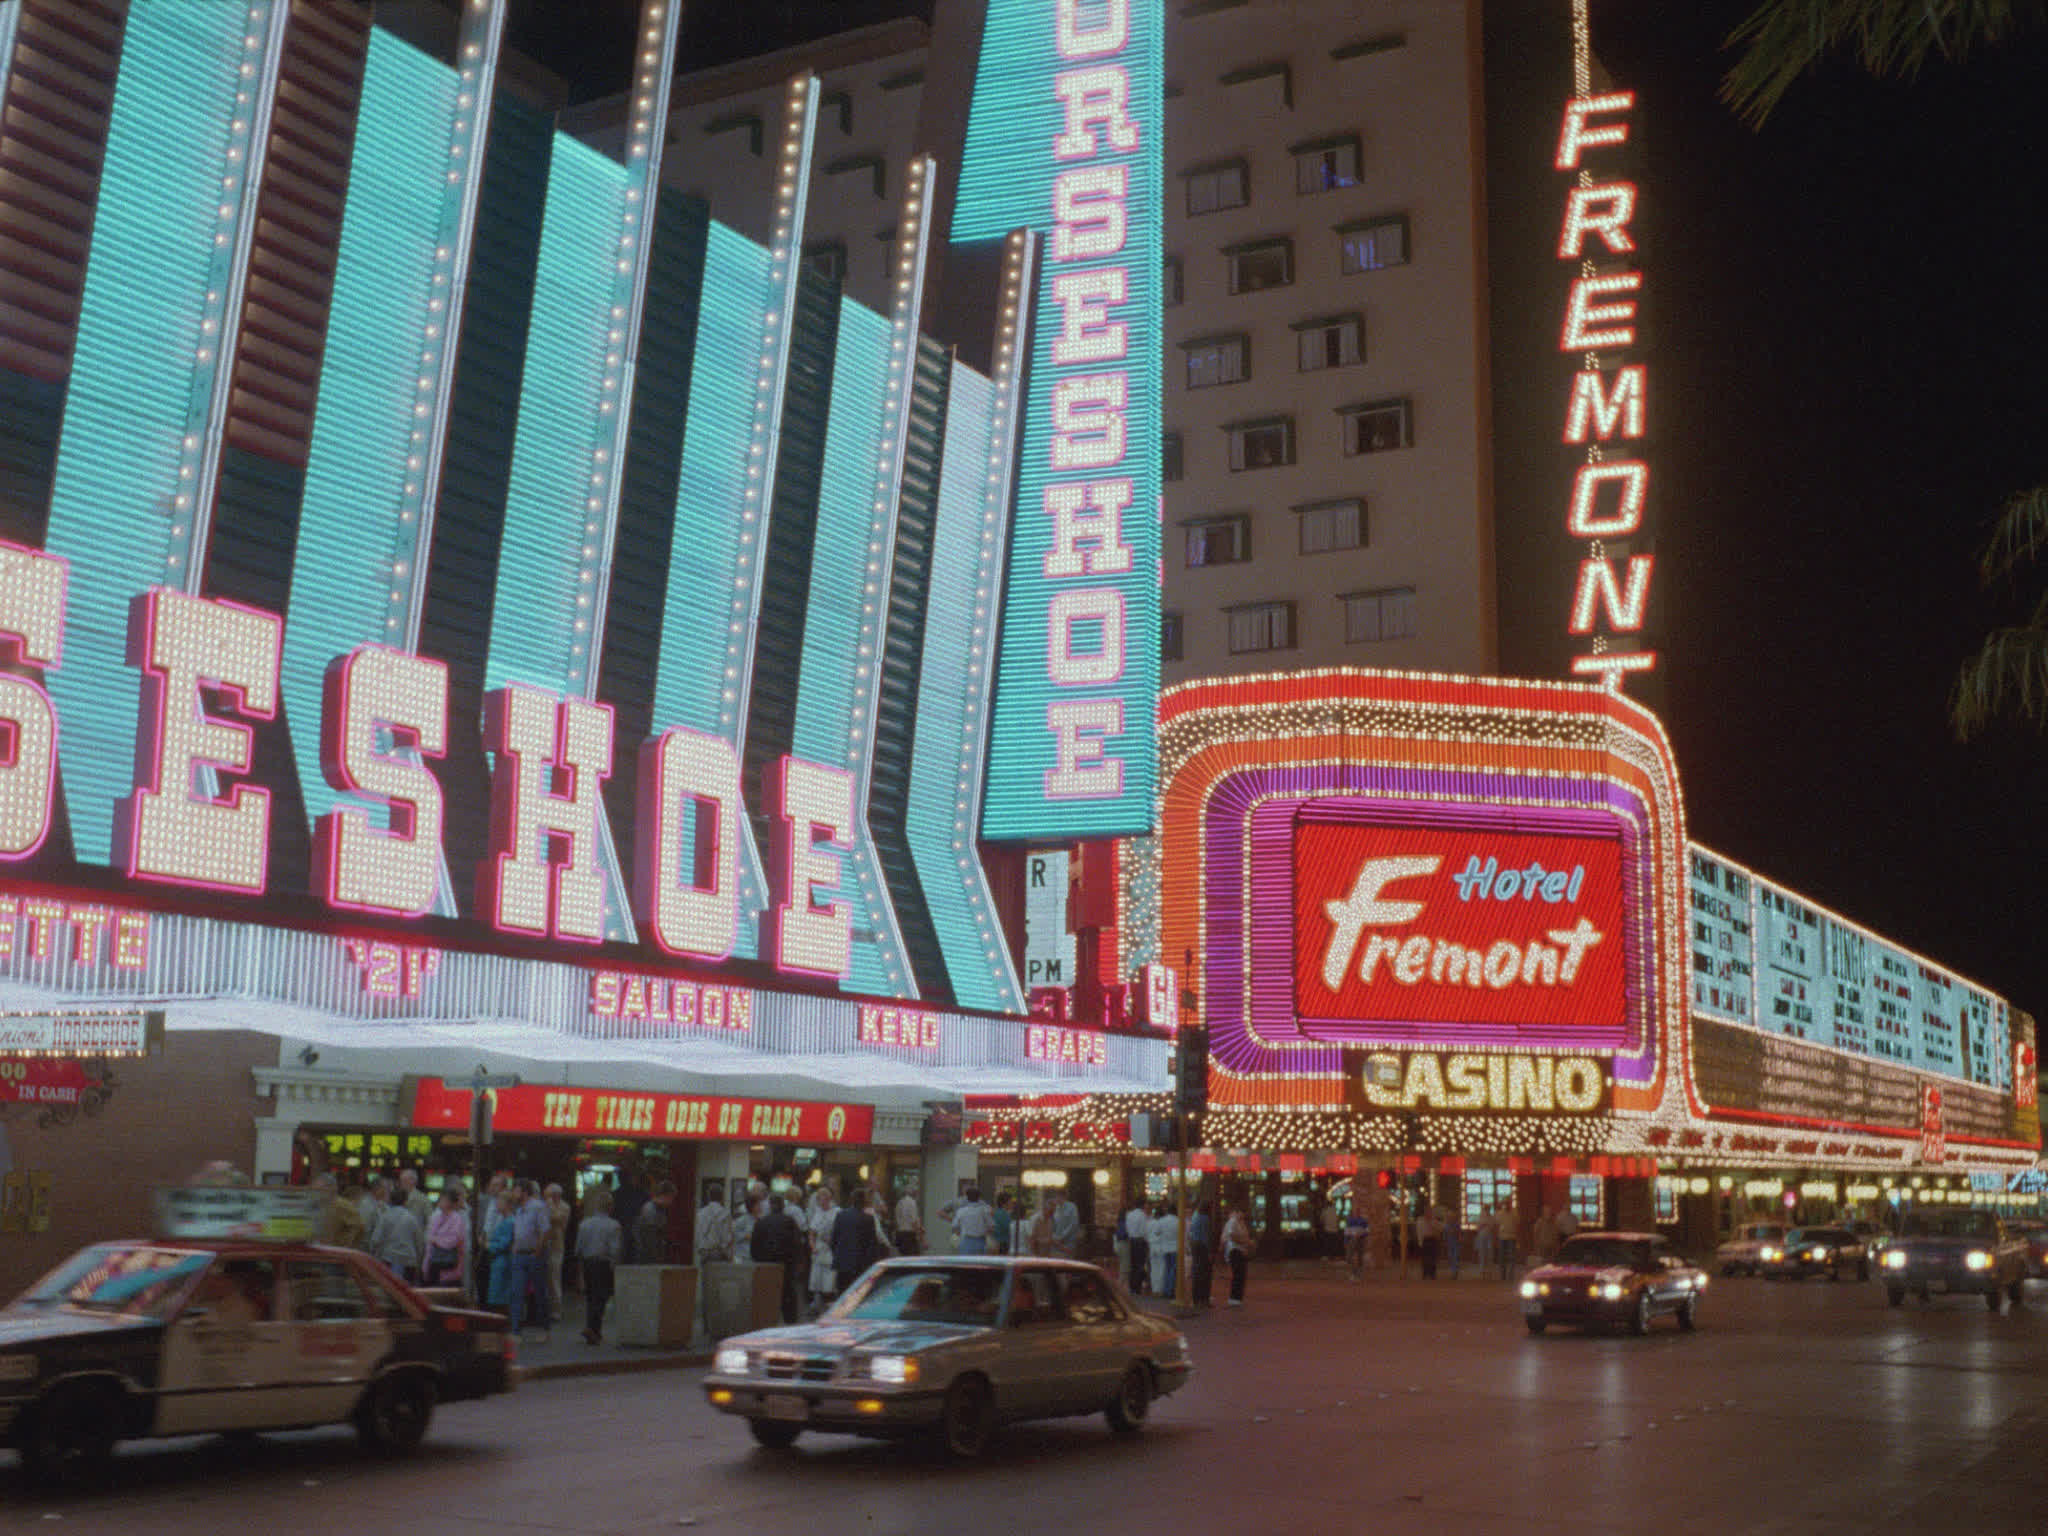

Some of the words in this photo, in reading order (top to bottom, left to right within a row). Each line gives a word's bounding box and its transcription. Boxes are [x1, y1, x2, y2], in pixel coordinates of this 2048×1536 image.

[1555, 91, 1656, 695] FREMONT
[1453, 855, 1586, 904] Hotel
[1321, 854, 1603, 993] Fremont
[590, 968, 752, 1031] SALOON
[52, 1019, 139, 1046] HORSESHOE
[858, 1003, 940, 1048] KENO
[1026, 1022, 1108, 1065] CRAPS
[1362, 1051, 1603, 1111] CASINO
[543, 1092, 582, 1129] TEN
[595, 1095, 656, 1132] TIMES
[665, 1099, 710, 1134] ODDS
[718, 1102, 743, 1135] ON
[751, 1104, 803, 1137] CRAPS
